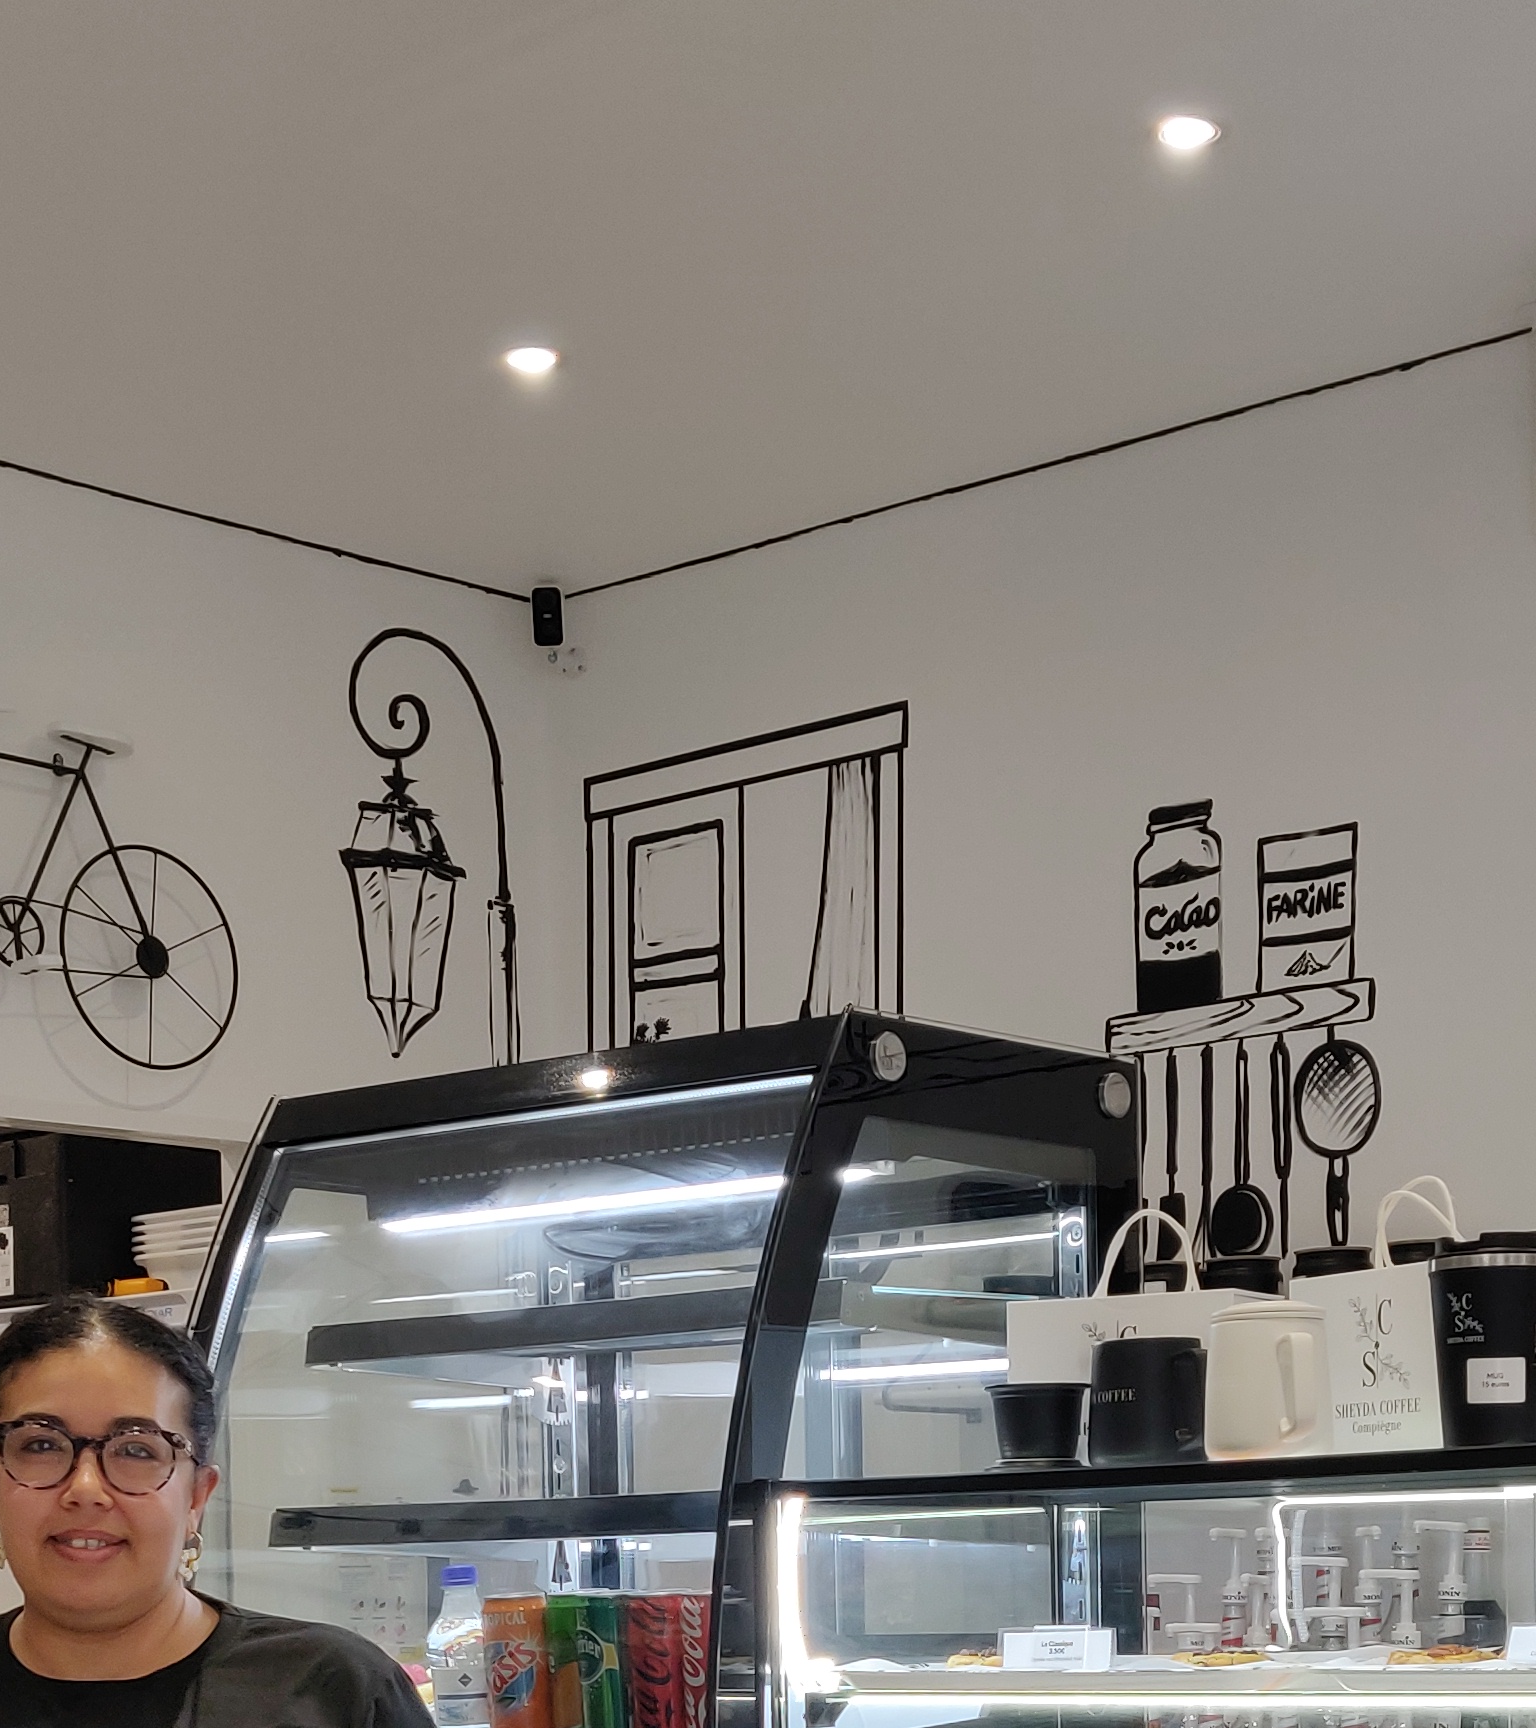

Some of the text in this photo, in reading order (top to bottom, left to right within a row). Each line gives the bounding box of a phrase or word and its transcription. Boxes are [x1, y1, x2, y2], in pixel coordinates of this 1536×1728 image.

[1335, 1397, 1422, 1420] SHEYDA COFFEE
[1352, 1420, 1402, 1437] Compiègne
